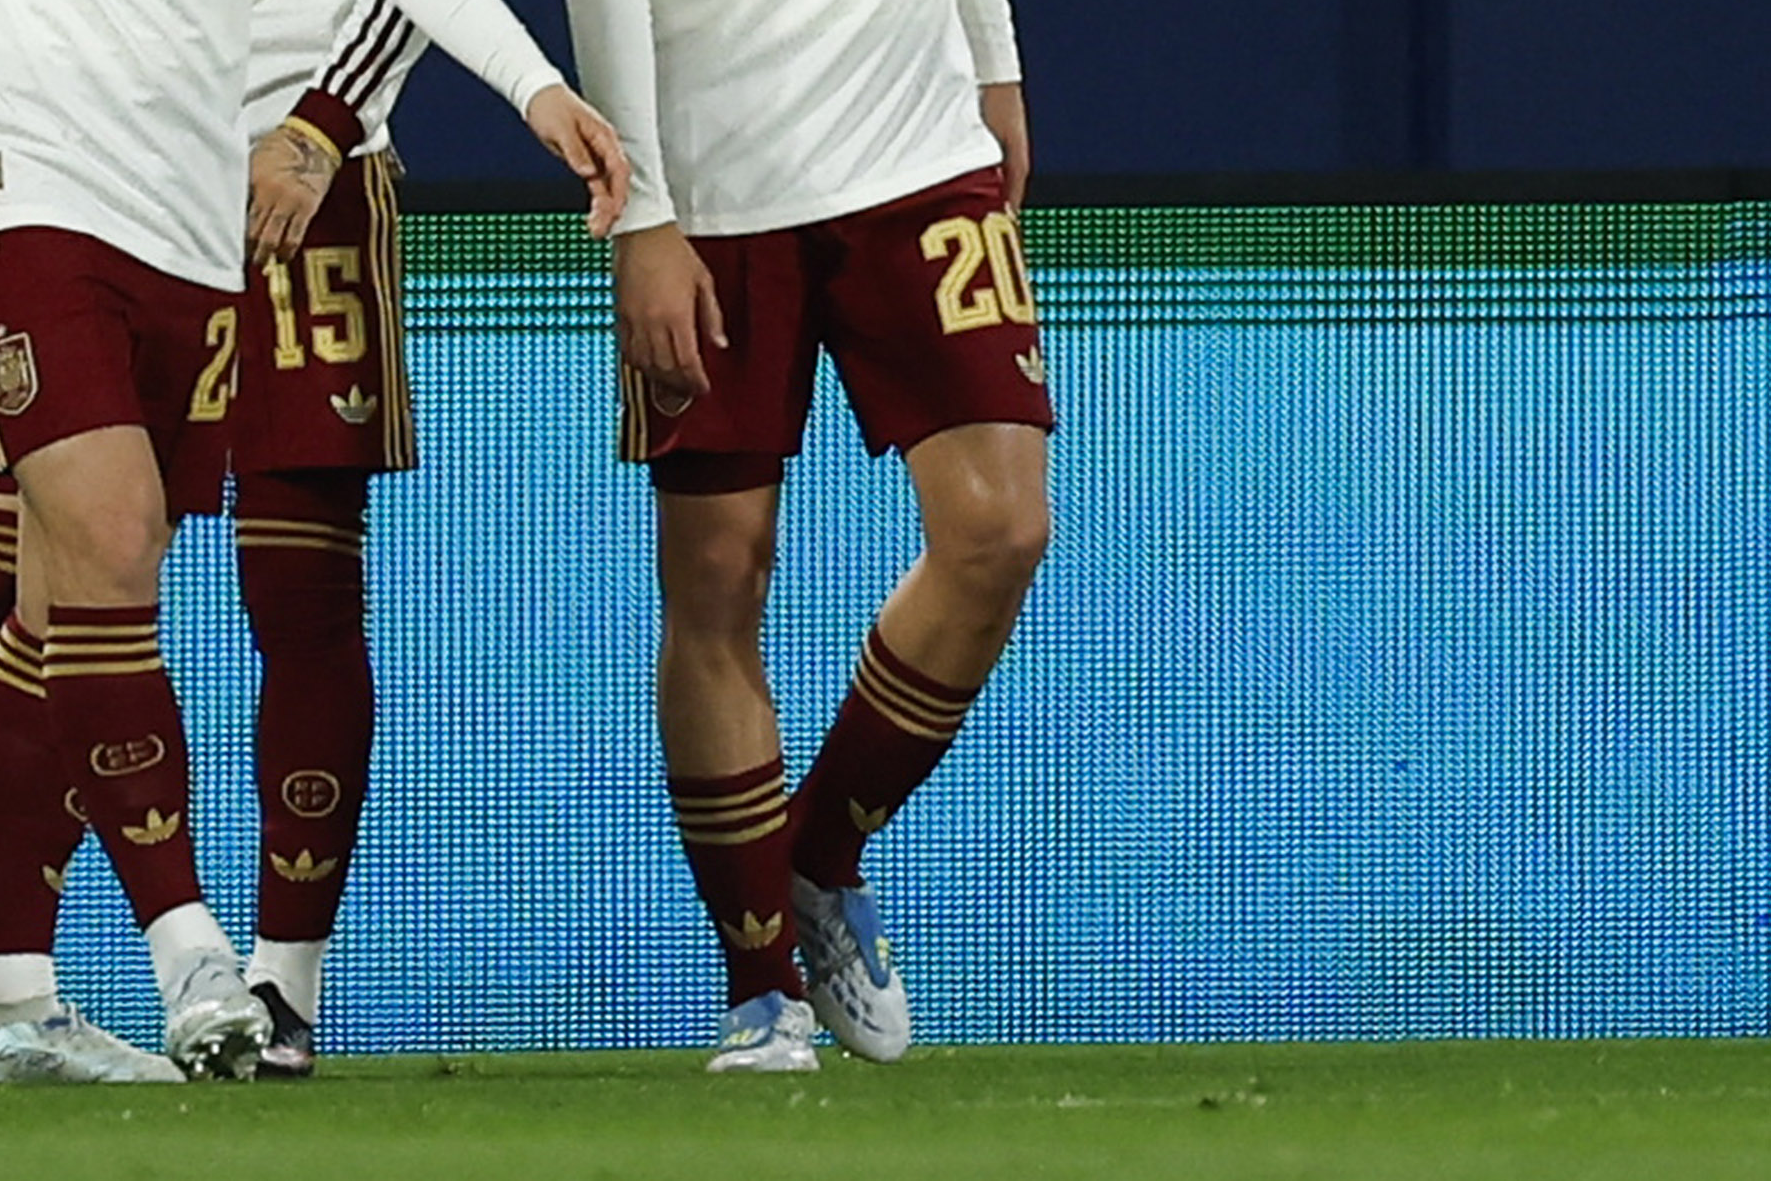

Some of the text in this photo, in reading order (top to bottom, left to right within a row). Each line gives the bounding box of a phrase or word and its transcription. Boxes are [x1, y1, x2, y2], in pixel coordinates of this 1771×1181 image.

[261, 245, 367, 369] 15
[919, 211, 1036, 335] 20
[186, 306, 240, 422] 2
